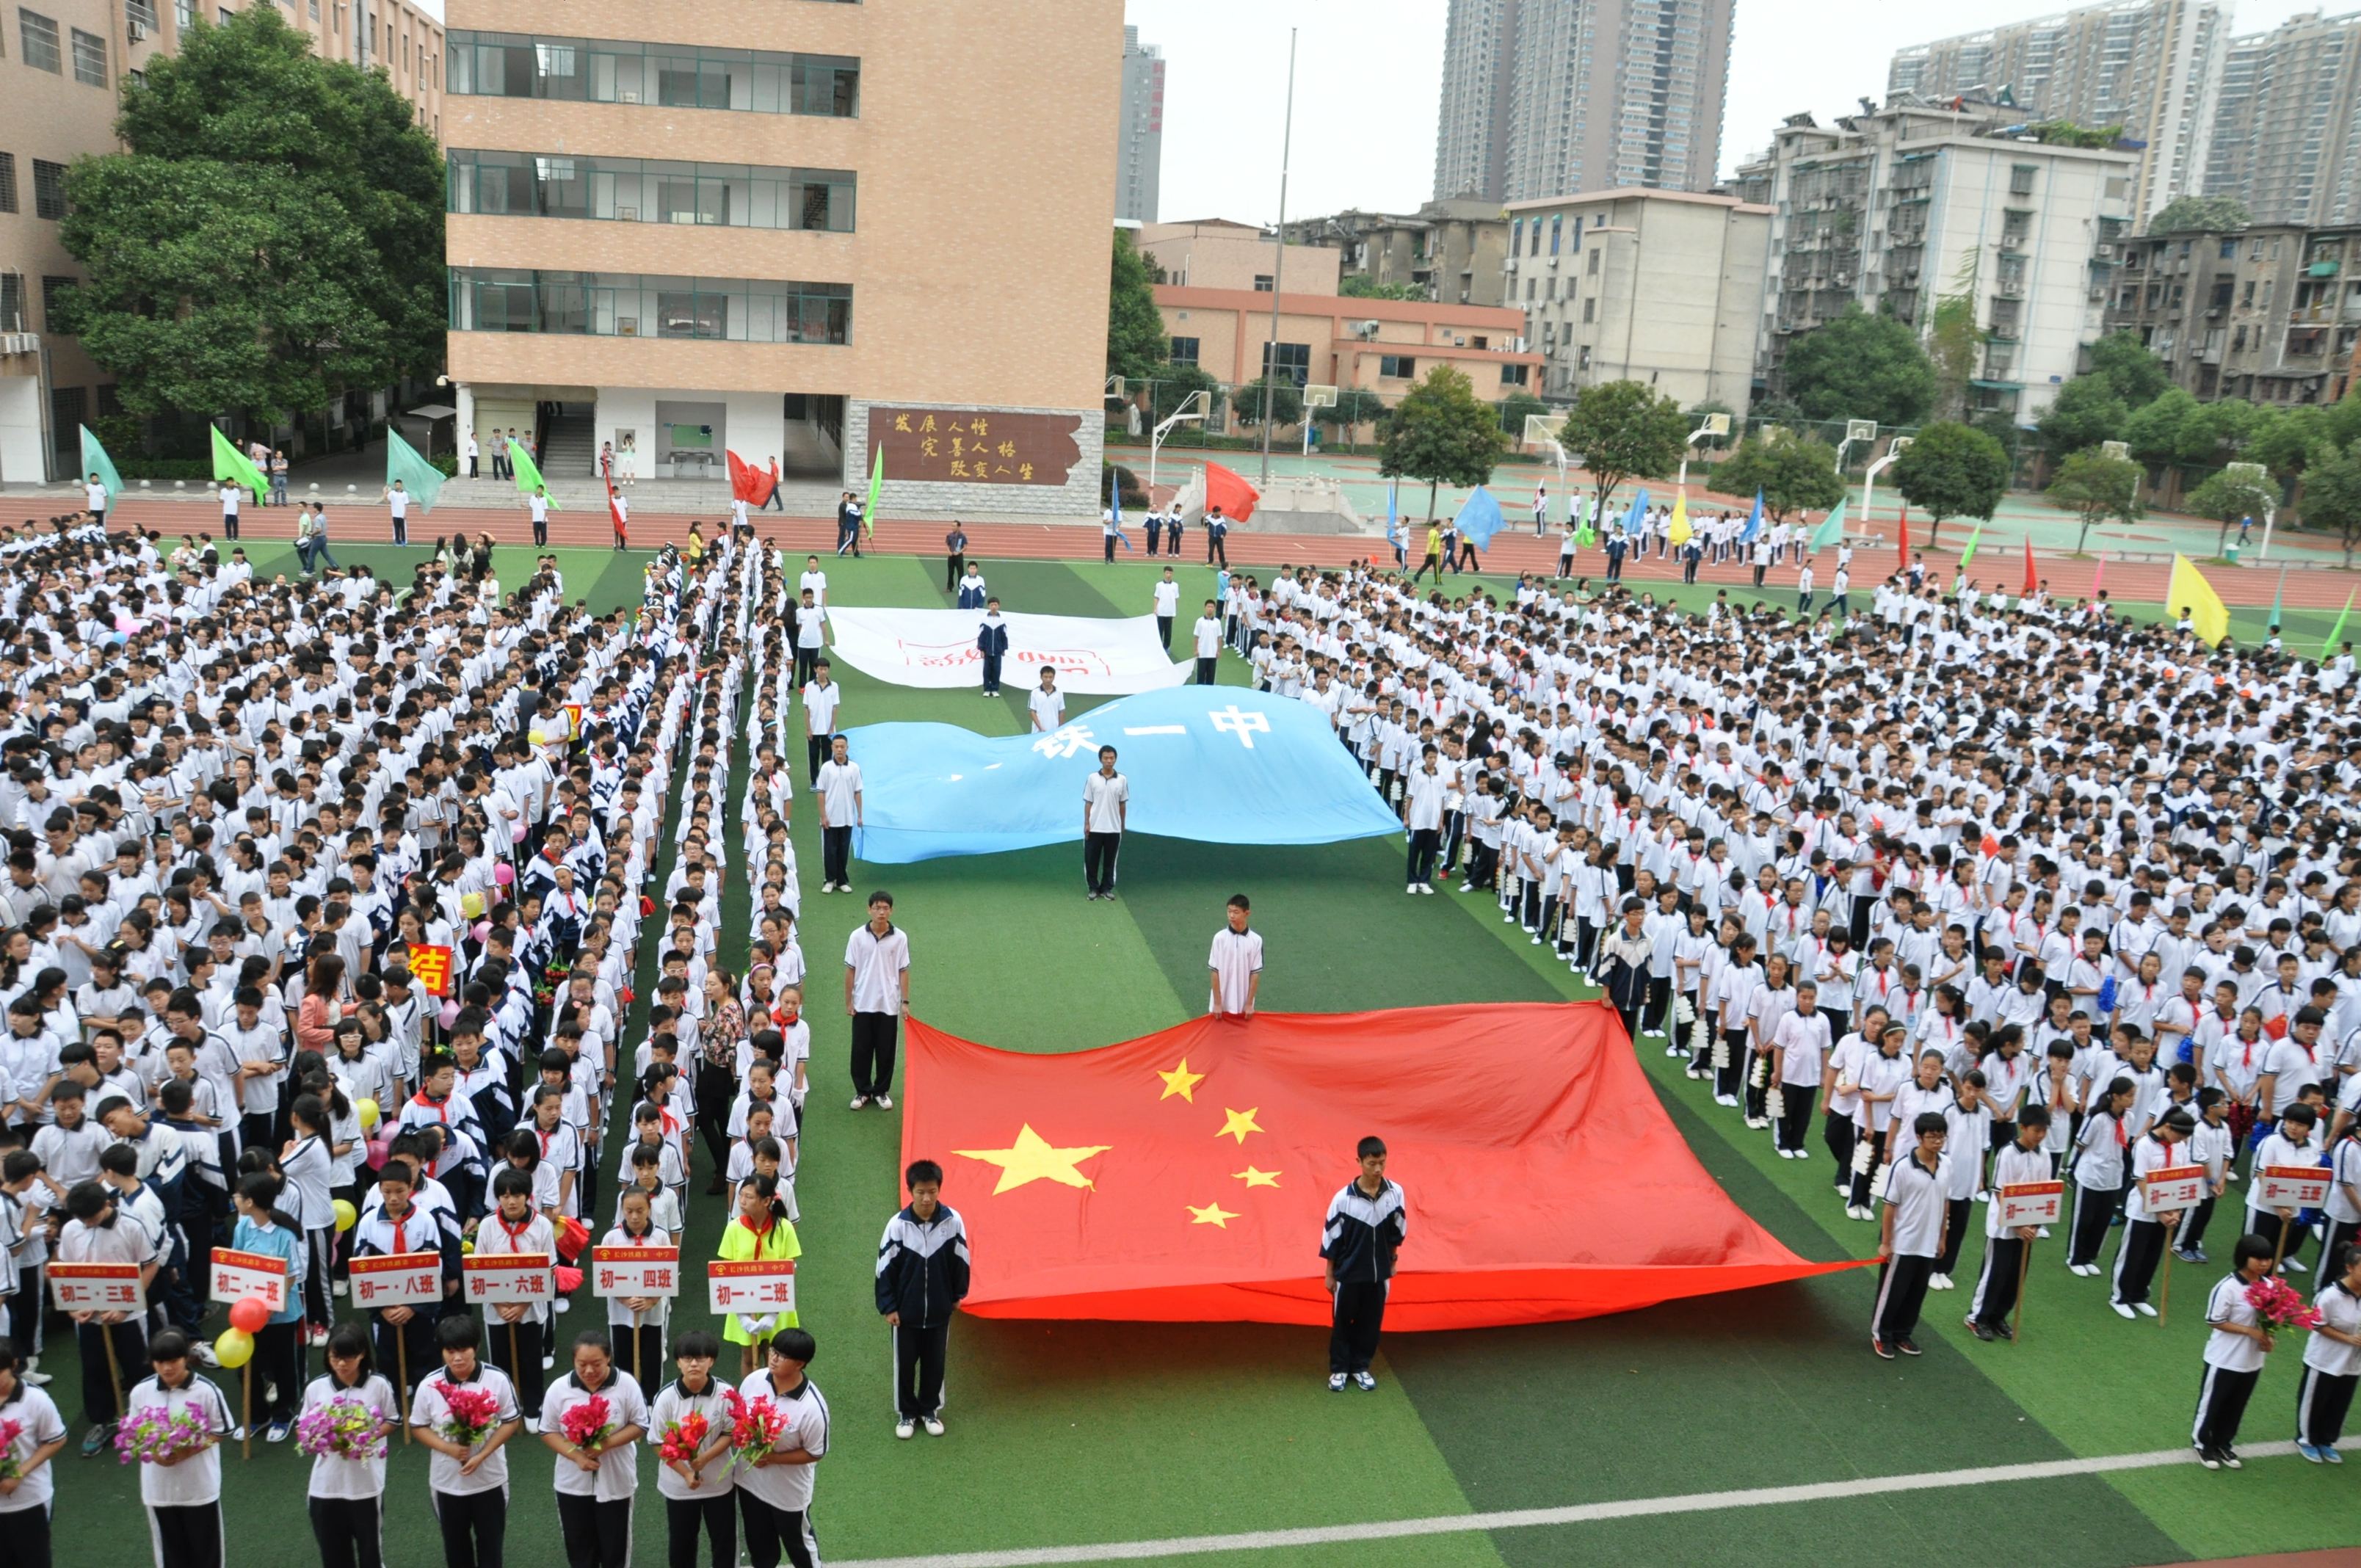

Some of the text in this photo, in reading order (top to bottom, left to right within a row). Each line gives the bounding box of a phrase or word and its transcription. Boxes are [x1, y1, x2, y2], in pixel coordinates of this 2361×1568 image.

[895, 413, 989, 436] 发展人性
[921, 437, 1017, 459] 完善人格
[951, 460, 1034, 481] 改变人生
[408, 946, 446, 991] 结
